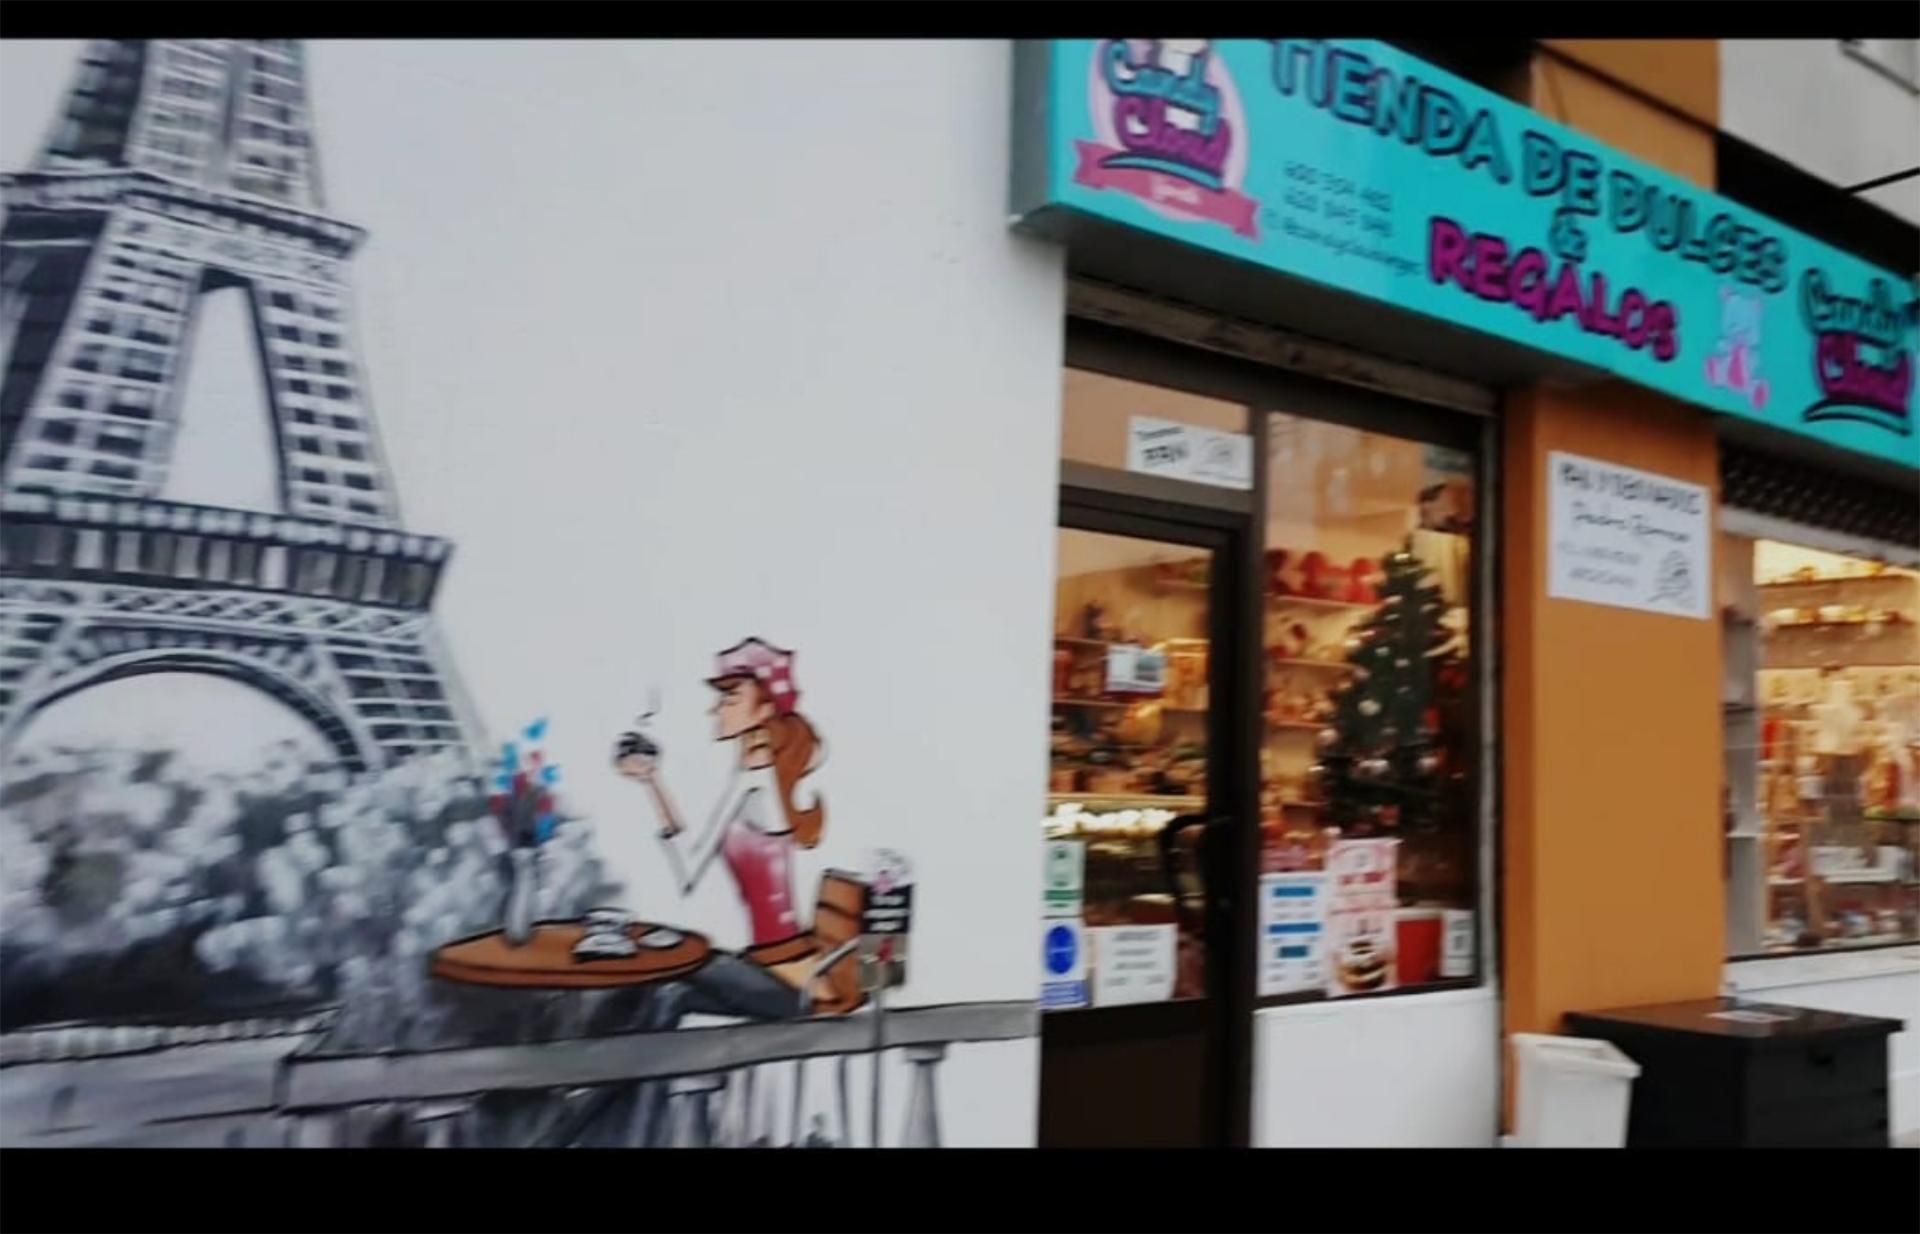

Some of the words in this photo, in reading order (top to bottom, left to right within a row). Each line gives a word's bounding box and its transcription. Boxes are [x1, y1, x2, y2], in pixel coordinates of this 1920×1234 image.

[1267, 39, 1513, 185] TIENDA
[1523, 130, 1600, 217] DE
[1607, 169, 1787, 294] DULCES
[1429, 215, 1678, 362] REGALOS
